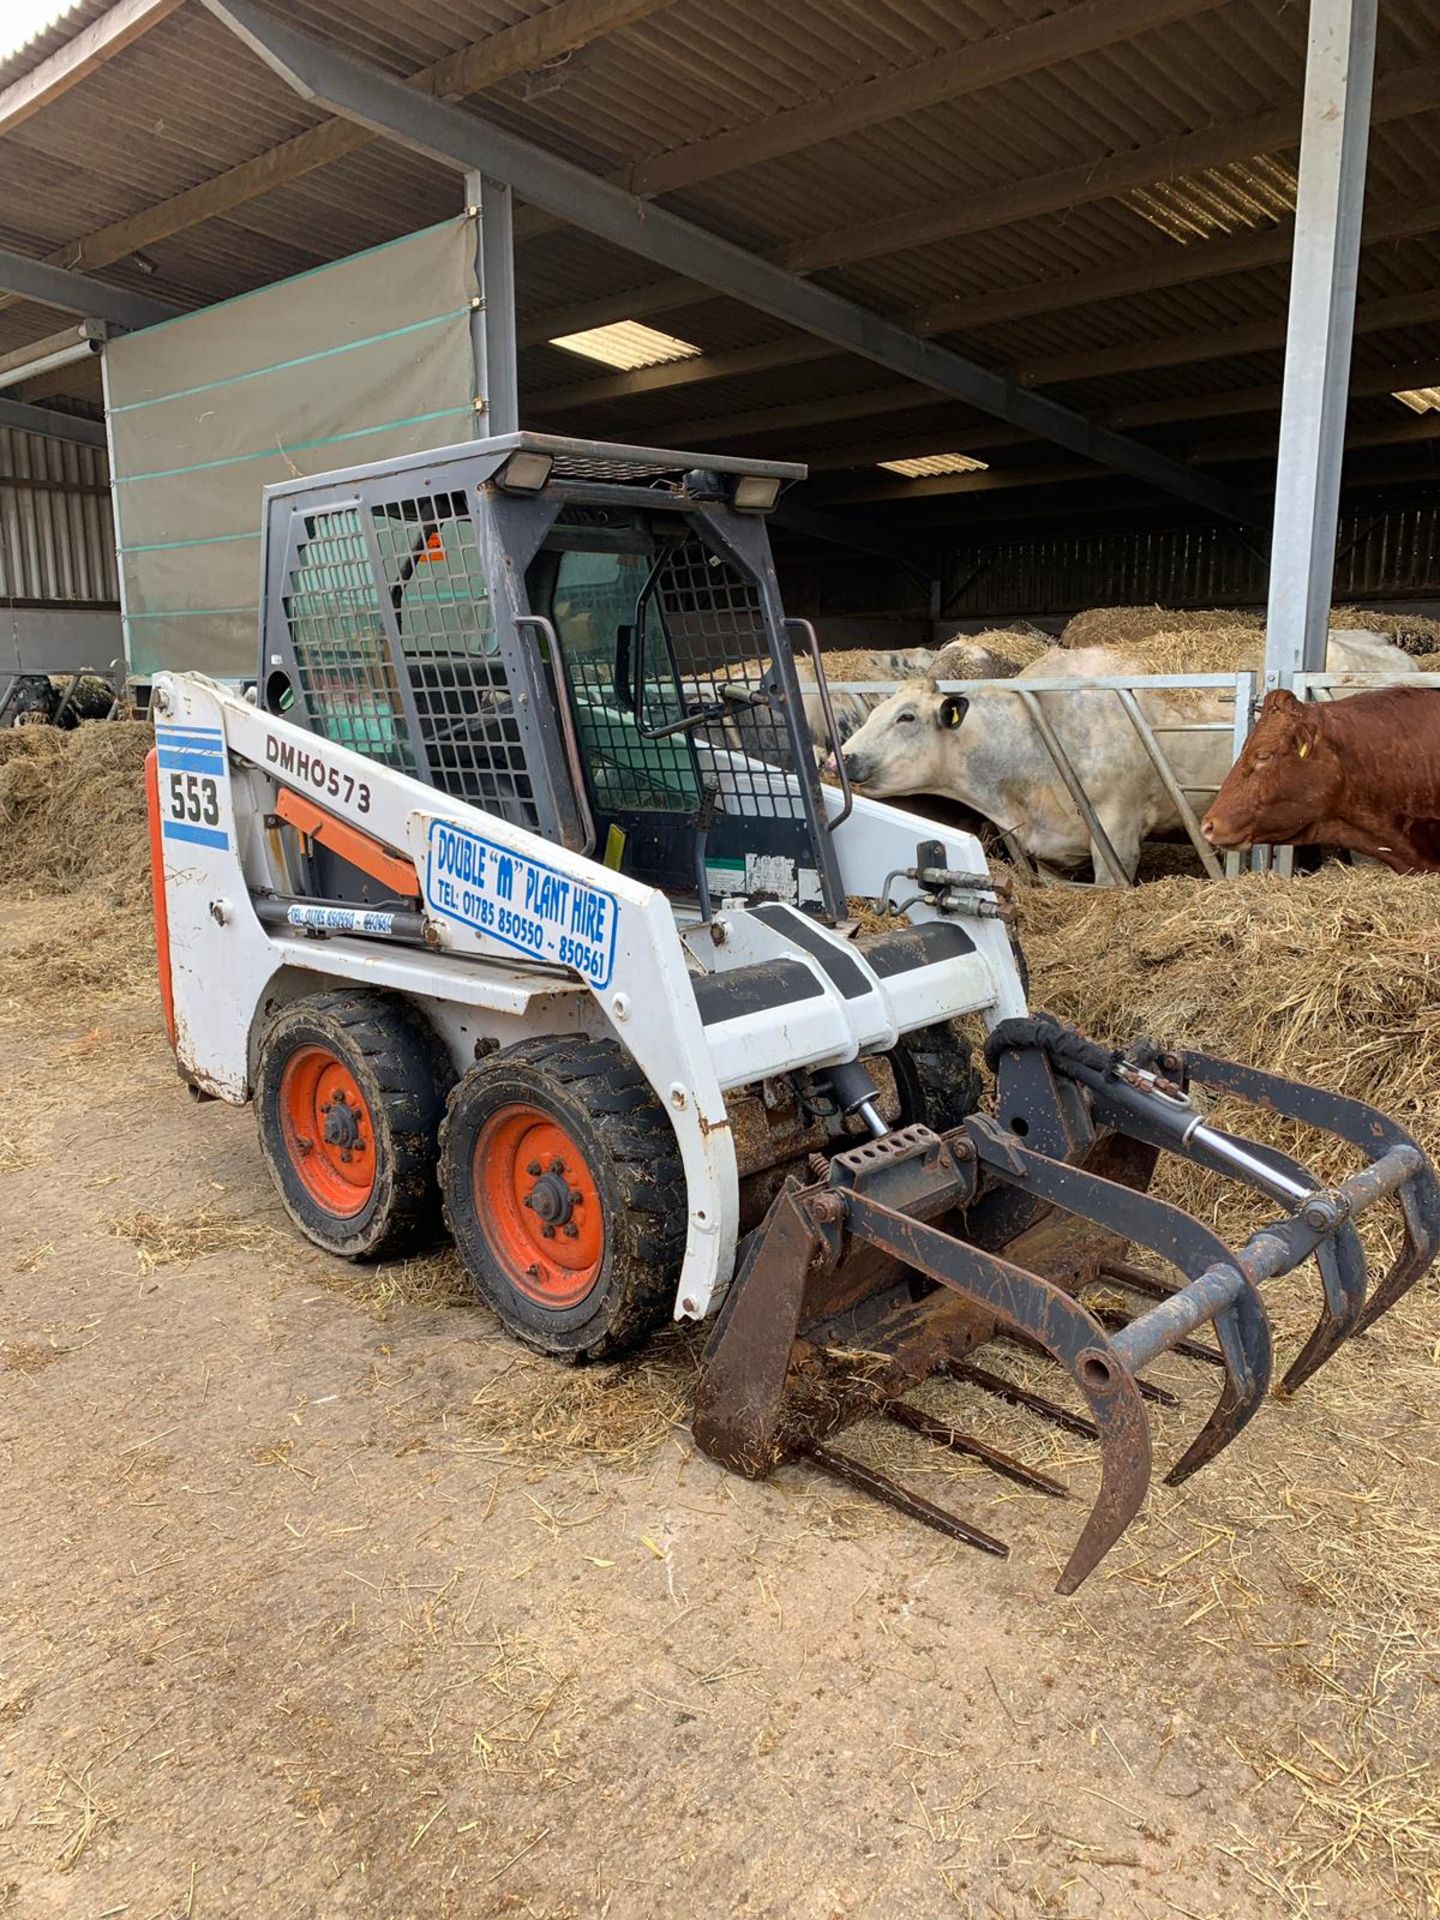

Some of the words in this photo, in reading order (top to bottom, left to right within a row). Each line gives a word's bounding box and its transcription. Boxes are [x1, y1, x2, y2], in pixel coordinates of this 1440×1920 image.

[170, 774, 219, 826] 553
[438, 829, 486, 889] DOUBLE
[525, 868, 569, 926] PLANT
[570, 887, 606, 944] HIRE
[438, 879, 459, 911] TEL:
[463, 890, 494, 926] 01785
[498, 907, 543, 950] 850550
[559, 935, 604, 979] 850561
